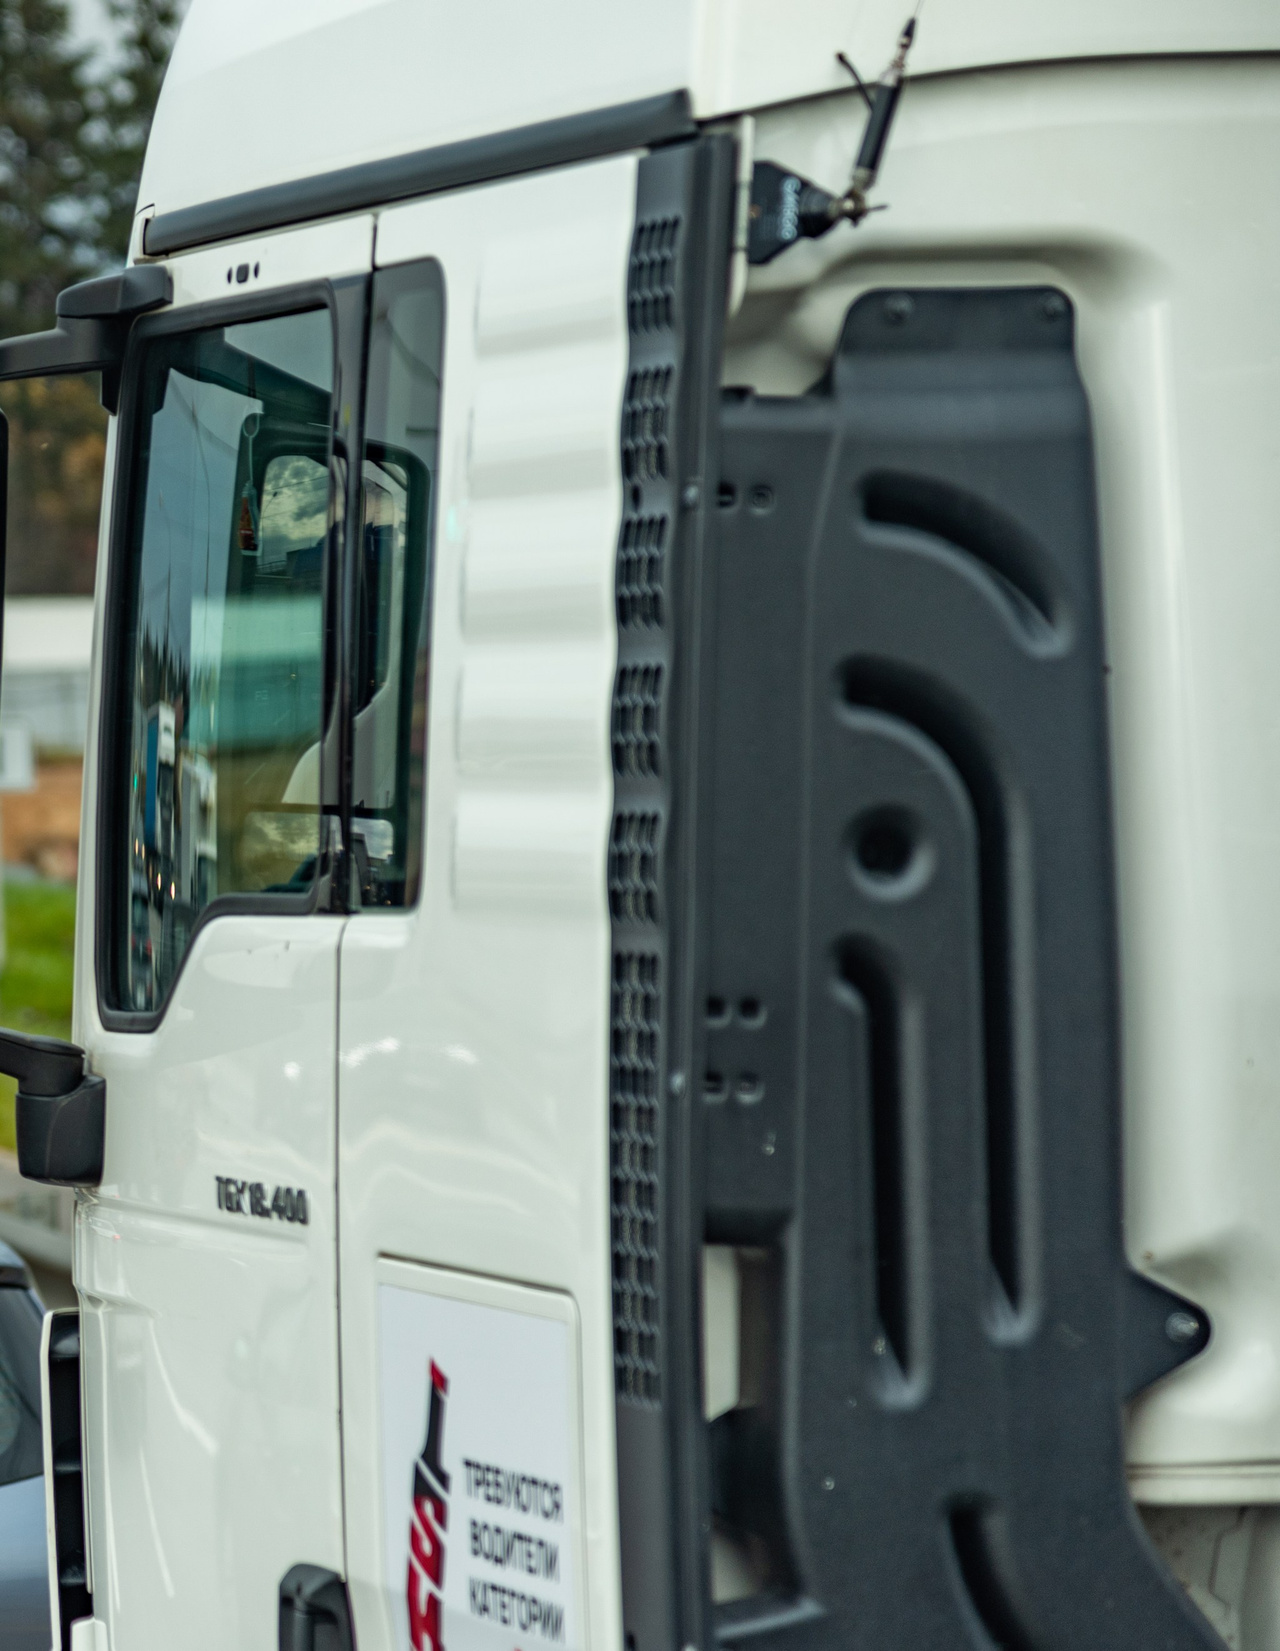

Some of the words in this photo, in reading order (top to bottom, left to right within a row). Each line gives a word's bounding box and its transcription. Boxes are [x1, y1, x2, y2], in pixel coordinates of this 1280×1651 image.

[215, 1175, 247, 1214] TGX
[463, 1457, 564, 1524] ТРЕБУЮТСЯ
[470, 1518, 561, 1584] ВОДИТЕЛИ
[468, 1575, 566, 1644] КАТЕГОРИИ
